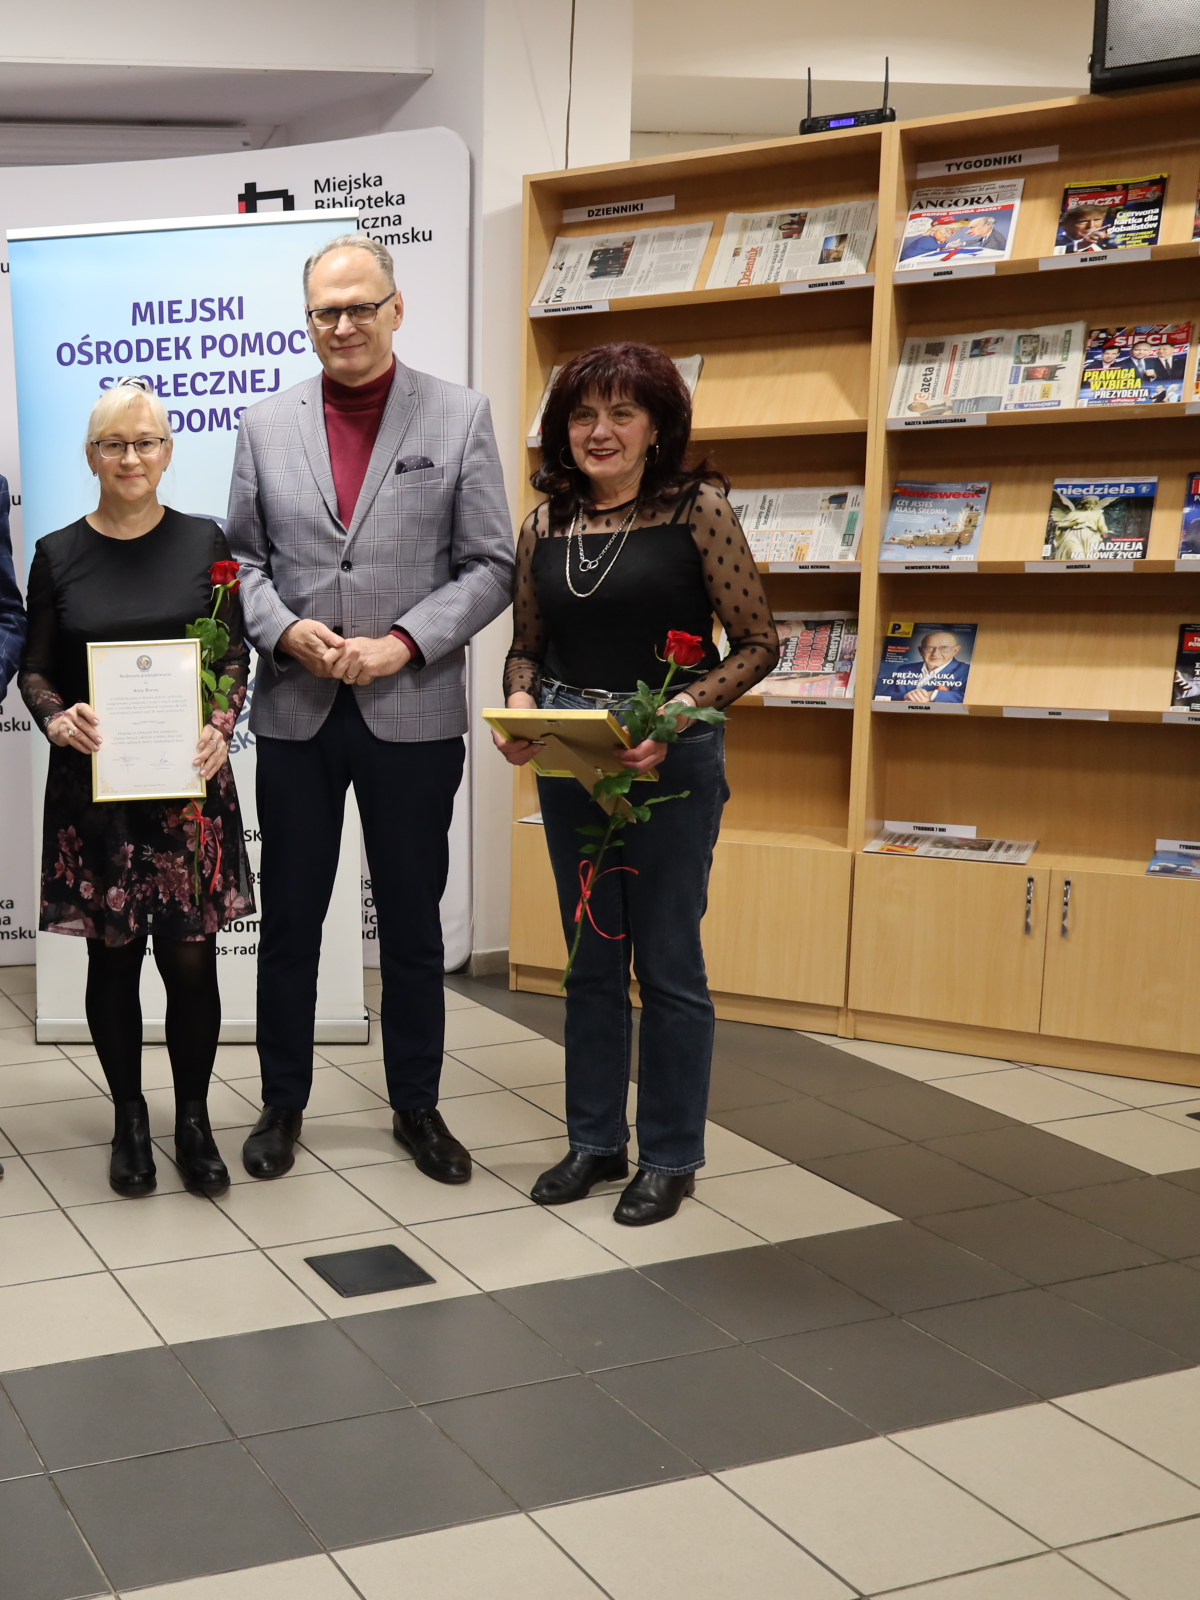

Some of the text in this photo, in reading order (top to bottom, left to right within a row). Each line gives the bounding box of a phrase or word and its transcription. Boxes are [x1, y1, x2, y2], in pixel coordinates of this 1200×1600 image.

[946, 154, 1022, 172] TYGODNIKI
[314, 172, 383, 194] Miejska
[912, 195, 994, 211] ANGORA
[588, 203, 644, 218] DZIENNIKI
[1116, 208, 1160, 218] Czerwona
[1107, 222, 1158, 234] globalistów
[1114, 217, 1143, 226] kartka
[552, 286, 566, 302] DGP
[132, 296, 244, 326] MIEJSKI
[56, 334, 192, 366] OŚRODEK
[1084, 368, 1136, 382] PRAWICA
[1090, 378, 1142, 390] WYBIERA
[1094, 389, 1149, 398] PREZYDENTA
[894, 486, 982, 499] Newsweek
[1057, 484, 1135, 495] niedziela
[910, 500, 934, 508] JESTEŚ
[895, 506, 948, 516] KLASĄ ŚREDNIĄ
[1090, 542, 1144, 551] NADZIEJA
[1116, 550, 1142, 559] ŻYCIE
[807, 624, 832, 672] DORABIA
[822, 620, 844, 672] do emerytury
[781, 636, 798, 672] 90-letnia
